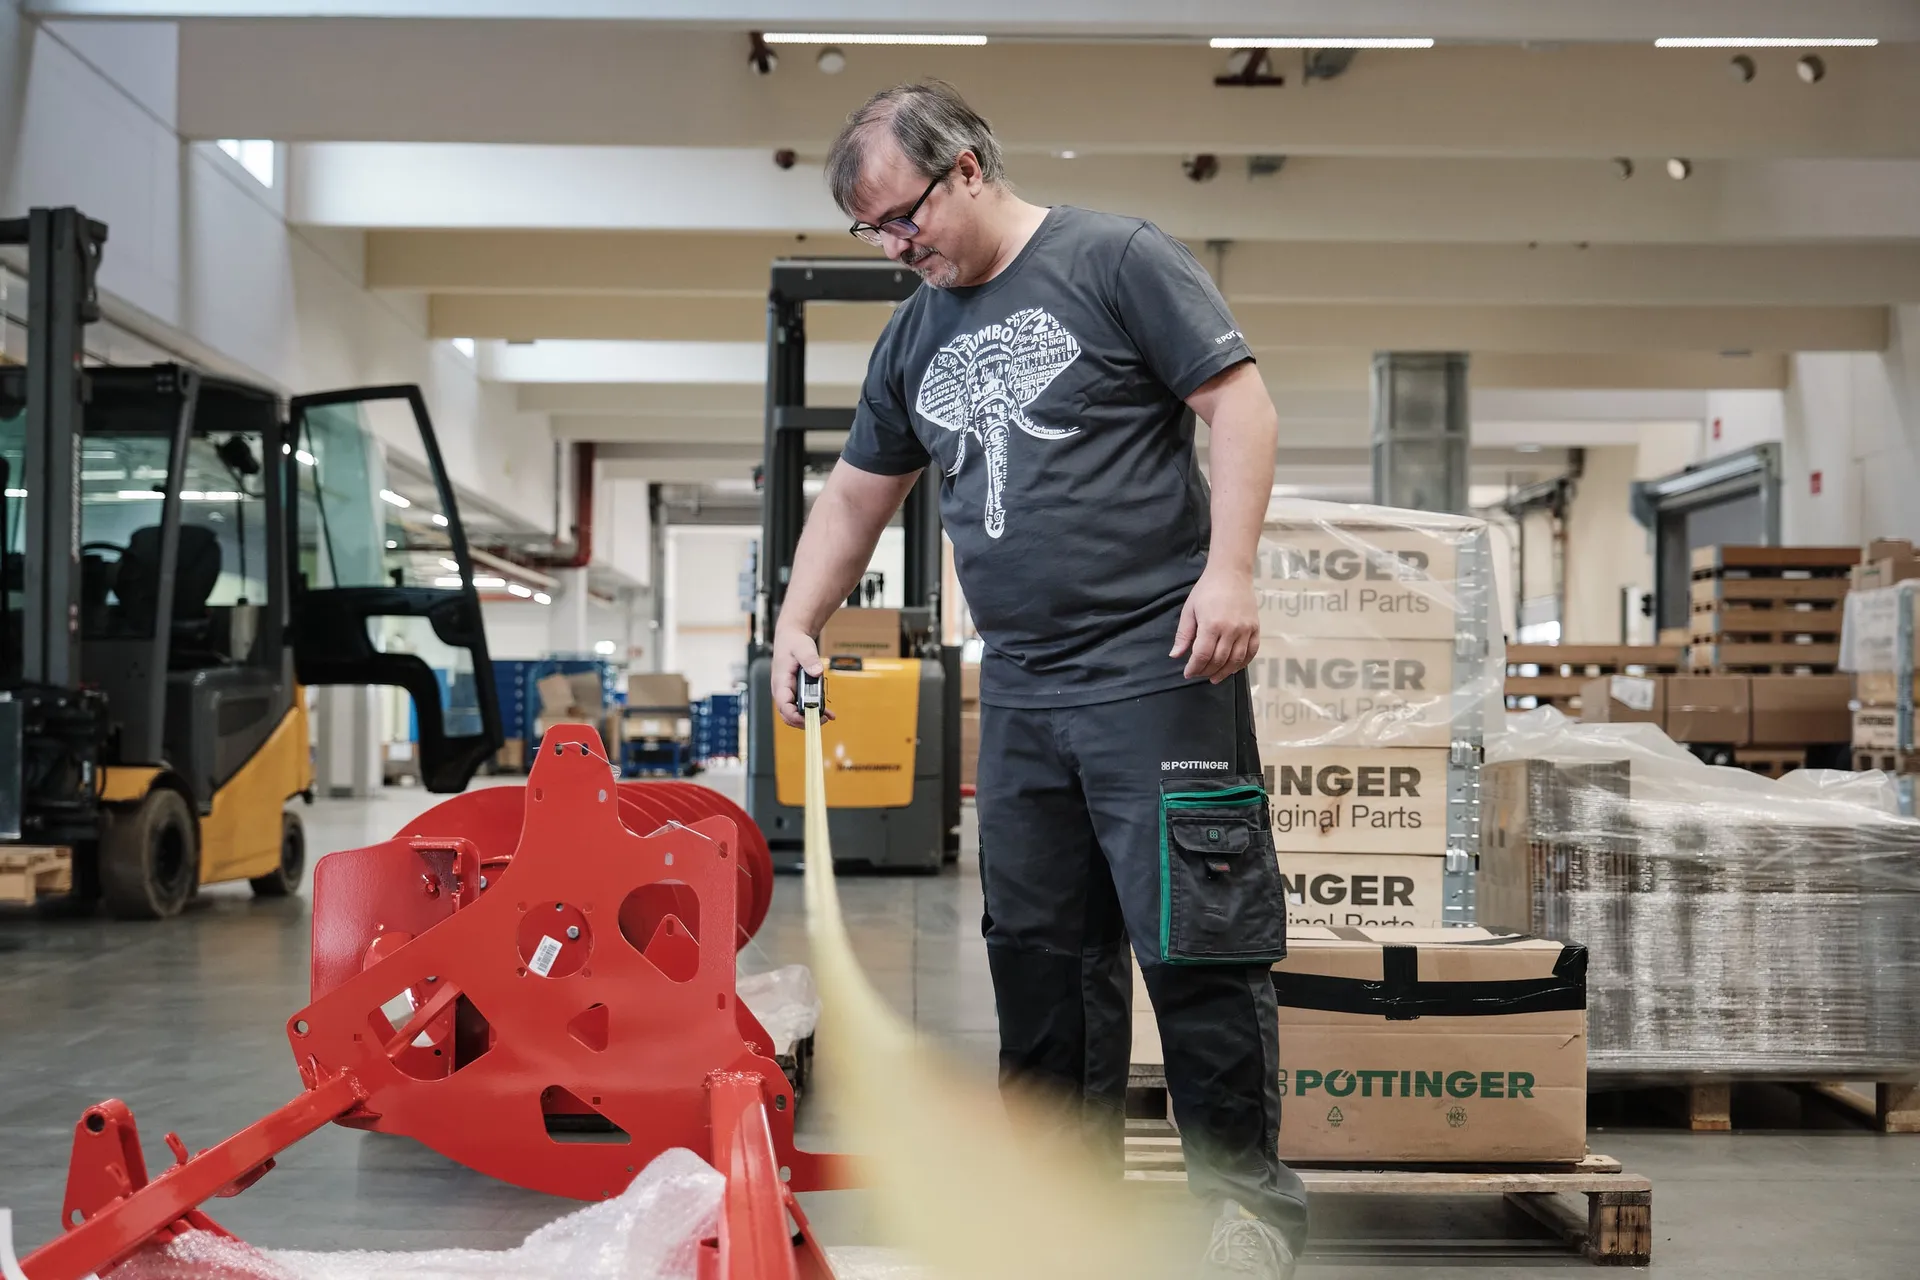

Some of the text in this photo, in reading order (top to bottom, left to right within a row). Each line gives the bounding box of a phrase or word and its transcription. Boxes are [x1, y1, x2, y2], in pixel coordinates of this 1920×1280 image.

[965, 323, 1014, 360] JUMBO
[1359, 588, 1430, 613] Parts
[1264, 765, 1421, 797] INGER
[1271, 804, 1422, 833] iginal Parts
[1295, 1068, 1536, 1099] PÖTTINGER
